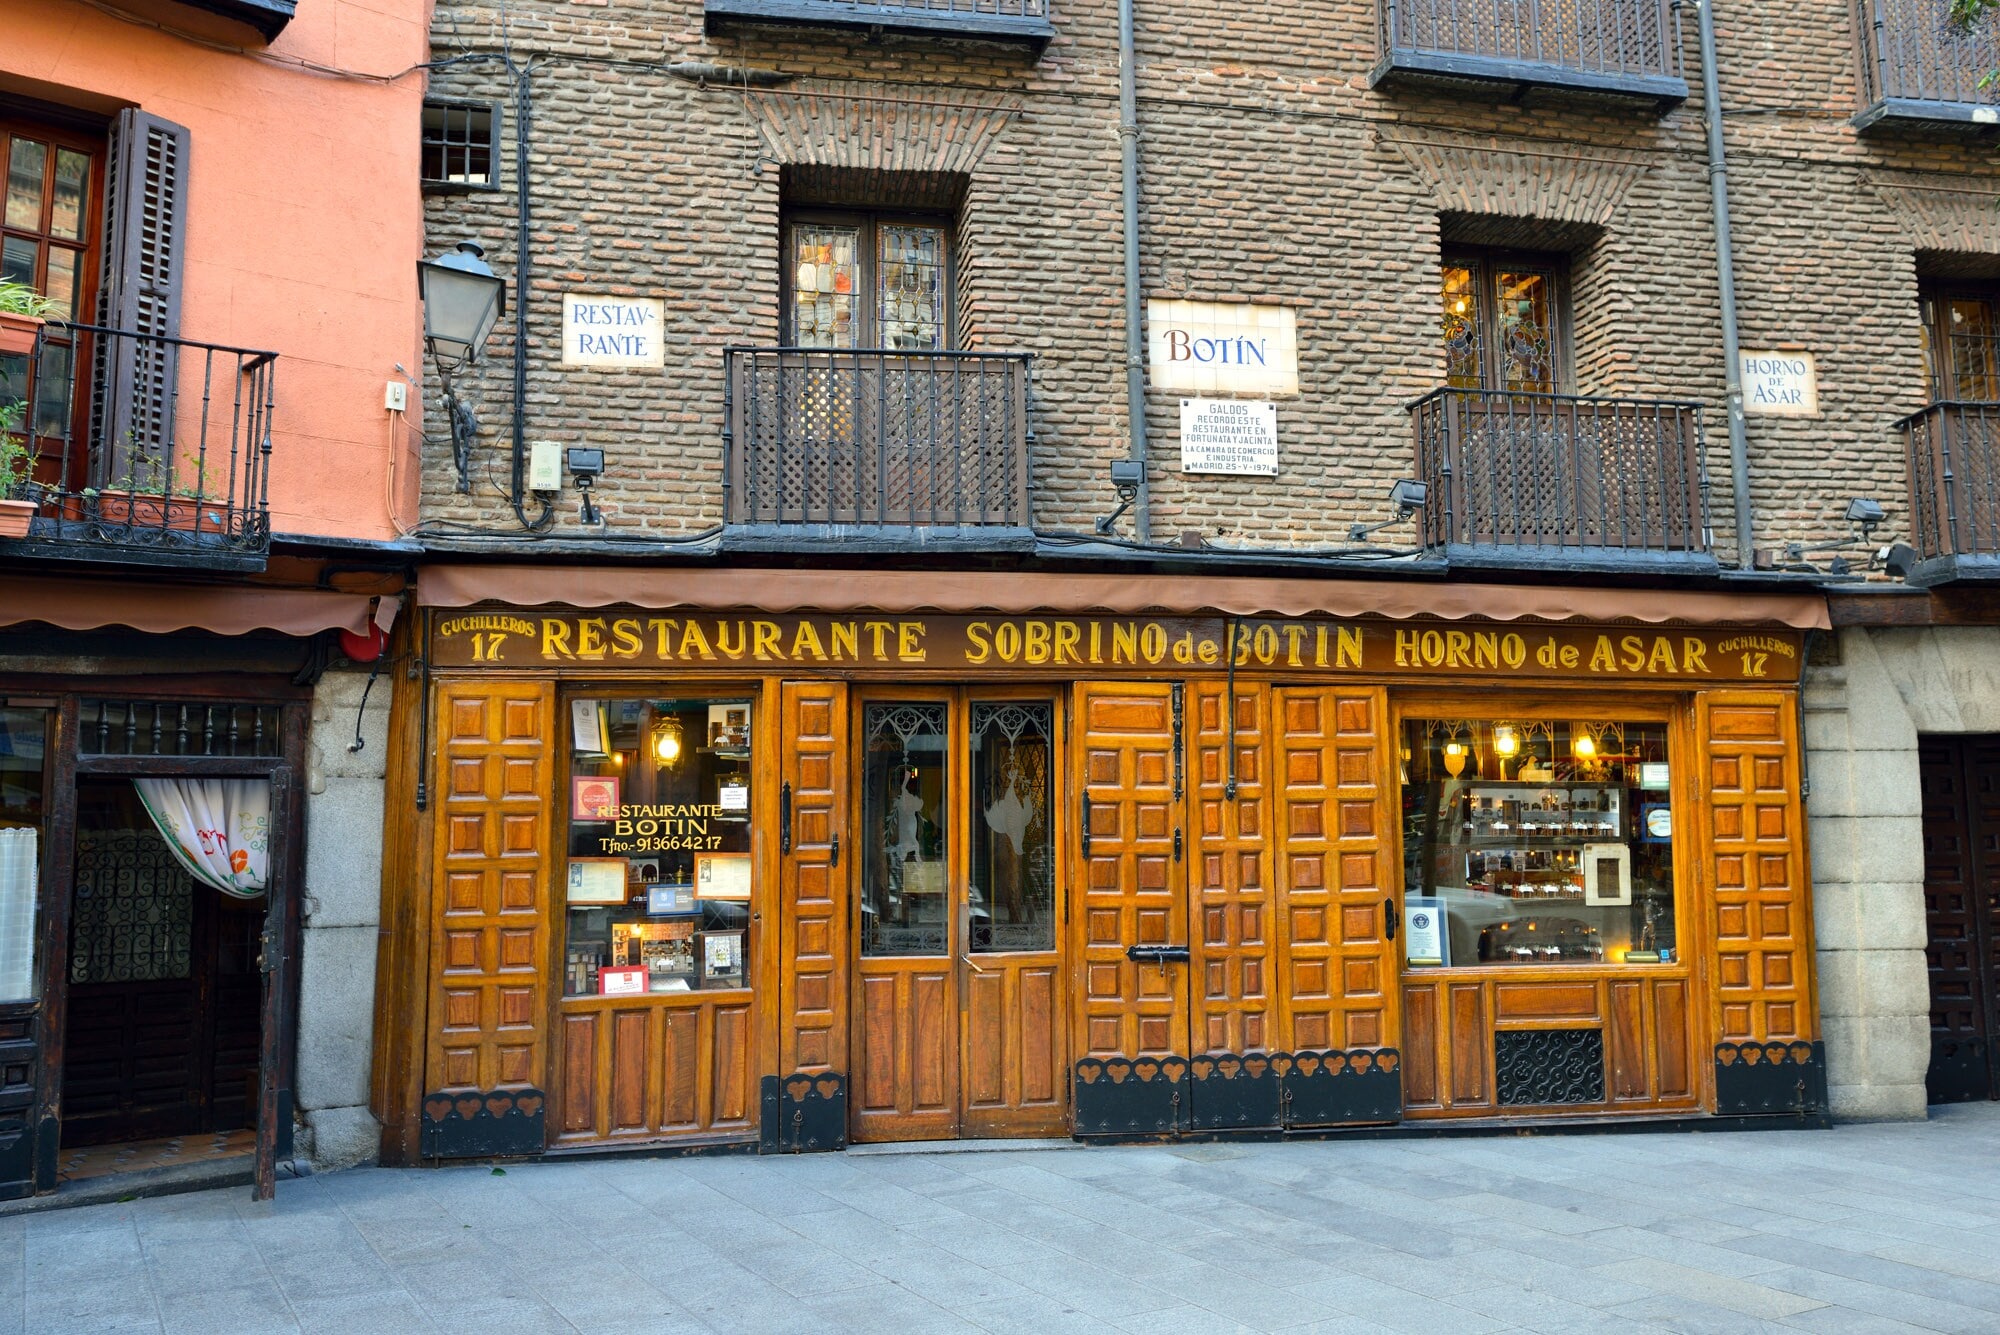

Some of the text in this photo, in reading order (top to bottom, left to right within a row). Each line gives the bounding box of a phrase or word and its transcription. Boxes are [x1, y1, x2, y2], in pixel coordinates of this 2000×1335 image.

[579, 333, 648, 356] RANTE
[1163, 329, 1266, 366] BOTÍN
[1745, 359, 1806, 375] HORNO
[1769, 377, 1784, 386] DE
[1753, 384, 1803, 405] ASAR
[1209, 404, 1248, 415] GALDOS
[1238, 416, 1261, 426] ESTE
[1192, 424, 1267, 436] RESTAURANTE EN
[1232, 435, 1238, 444] Y
[1185, 445, 1276, 456] LA CAMARA DE COMERCIO
[1206, 454, 1213, 462] E
[441, 616, 537, 638] CUCHILLEROS
[541, 618, 1712, 673] RESTAURANTE SOBRINO de BOTIN HORNO de ASAR
[1718, 635, 1795, 659] CUCHILLEROS
[597, 804, 723, 818] RESTAURANTE
[615, 819, 708, 836] BOTIN
